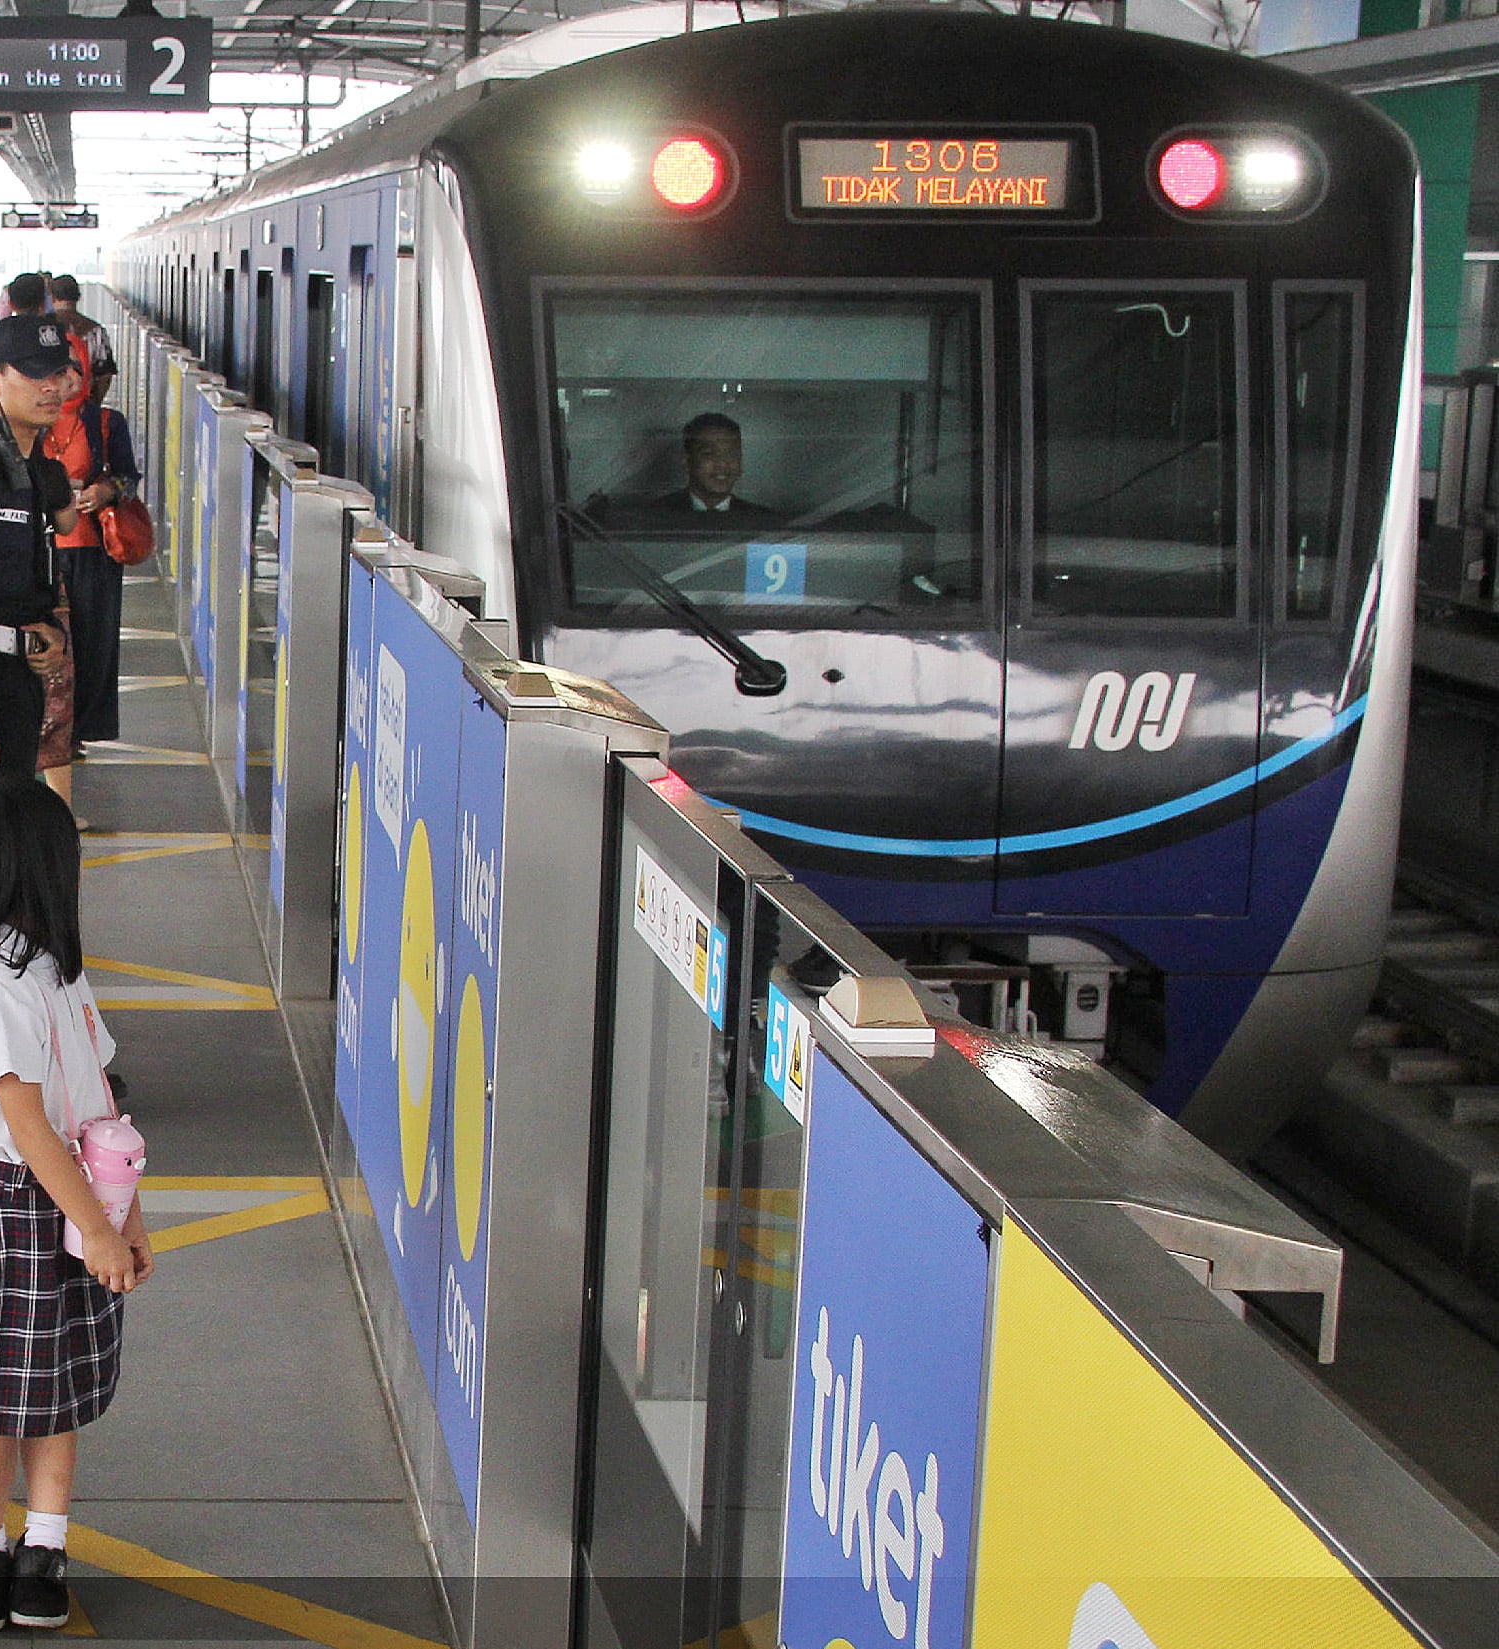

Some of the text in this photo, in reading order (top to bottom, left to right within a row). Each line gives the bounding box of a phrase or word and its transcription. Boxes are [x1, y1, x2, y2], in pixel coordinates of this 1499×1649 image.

[25, 68, 61, 87] the
[76, 69, 124, 87] trai
[50, 42, 100, 61] 11:00
[150, 37, 186, 95] 2
[871, 140, 1000, 173] 1306
[822, 175, 1049, 206] TIDAK MELAYANI
[764, 554, 788, 593] 9
[461, 809, 496, 968] tiket
[711, 939, 724, 1013] 5
[770, 1001, 786, 1082] 5
[446, 1263, 477, 1419] com
[809, 1305, 945, 1649] tiket
